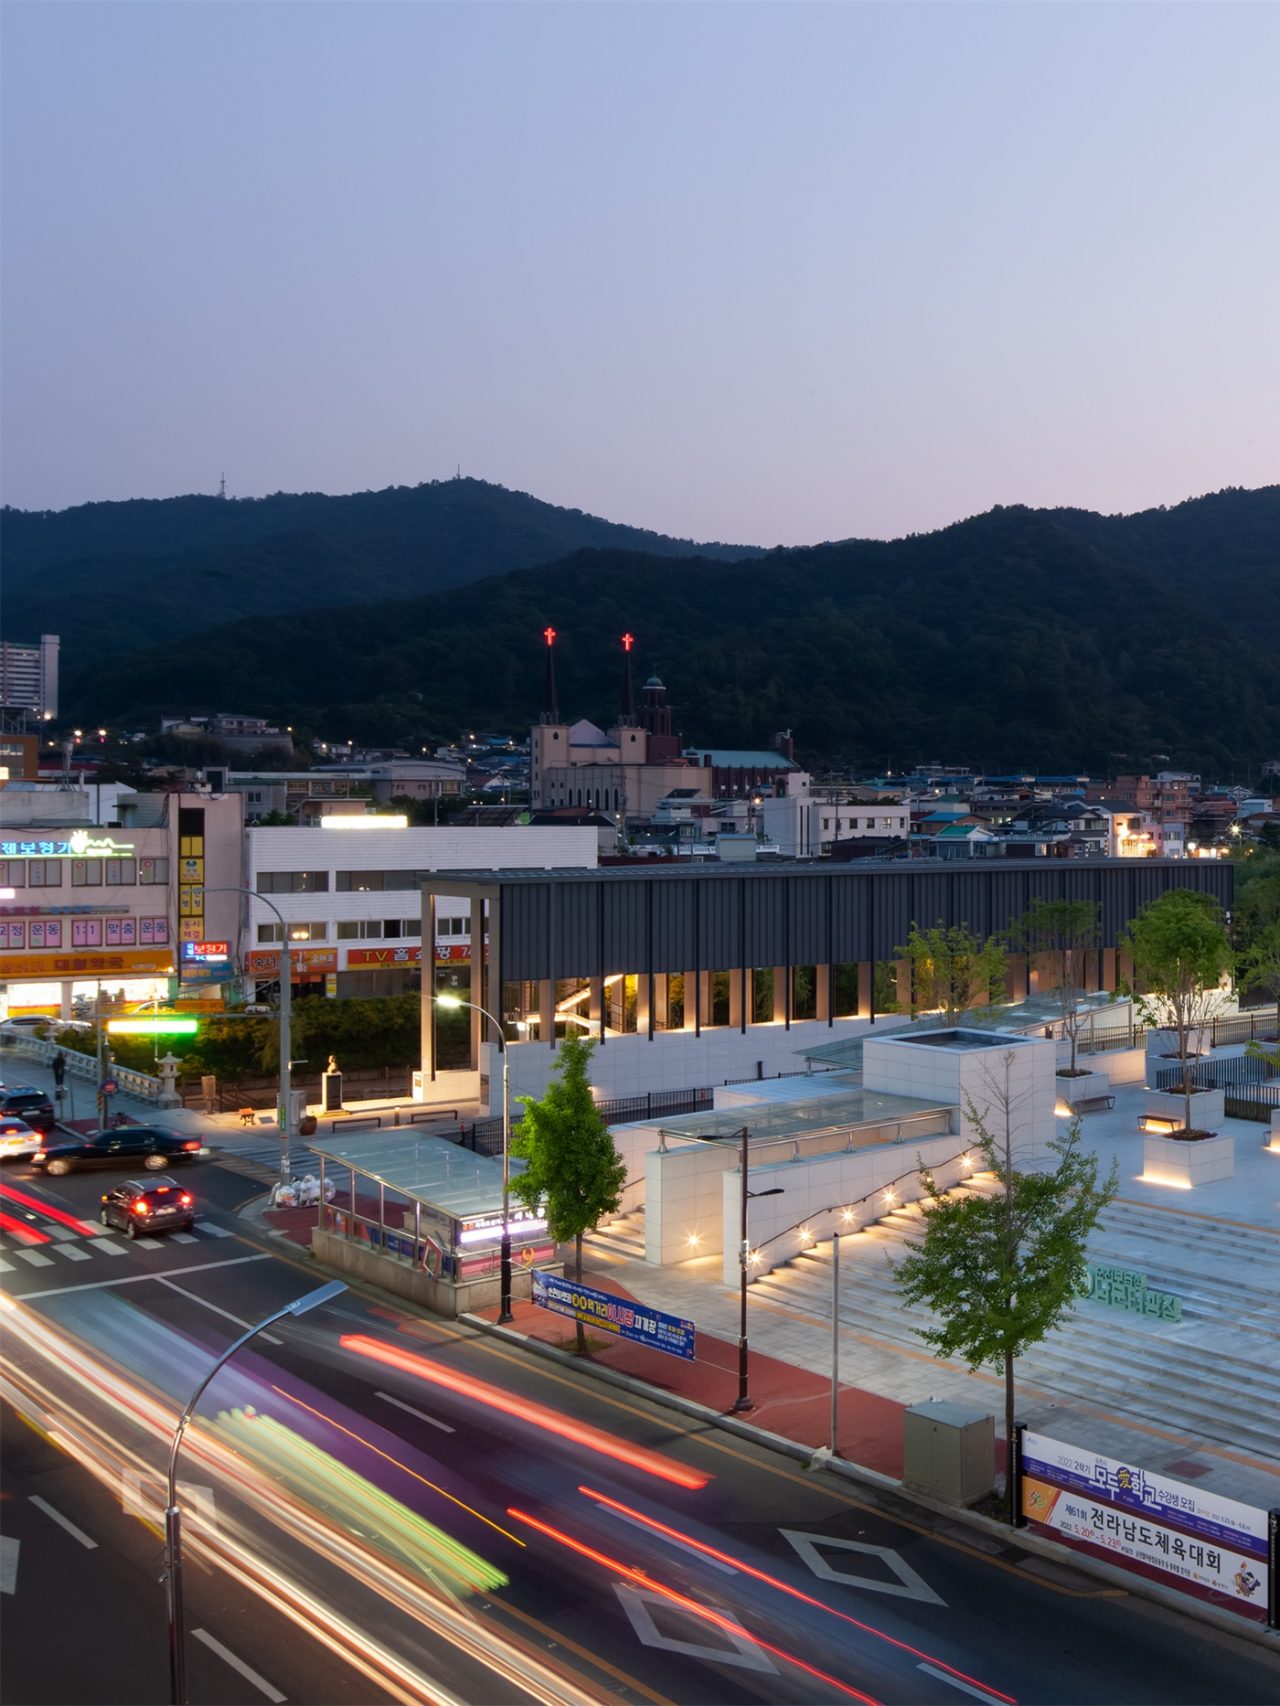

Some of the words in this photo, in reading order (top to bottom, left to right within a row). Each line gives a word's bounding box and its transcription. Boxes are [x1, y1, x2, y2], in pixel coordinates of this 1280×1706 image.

[362, 950, 388, 961] TV
[1158, 1490, 1179, 1507] 수강생
[1180, 1496, 1195, 1512] 모집
[1090, 1506, 1221, 1574] 전라남도체육대회
